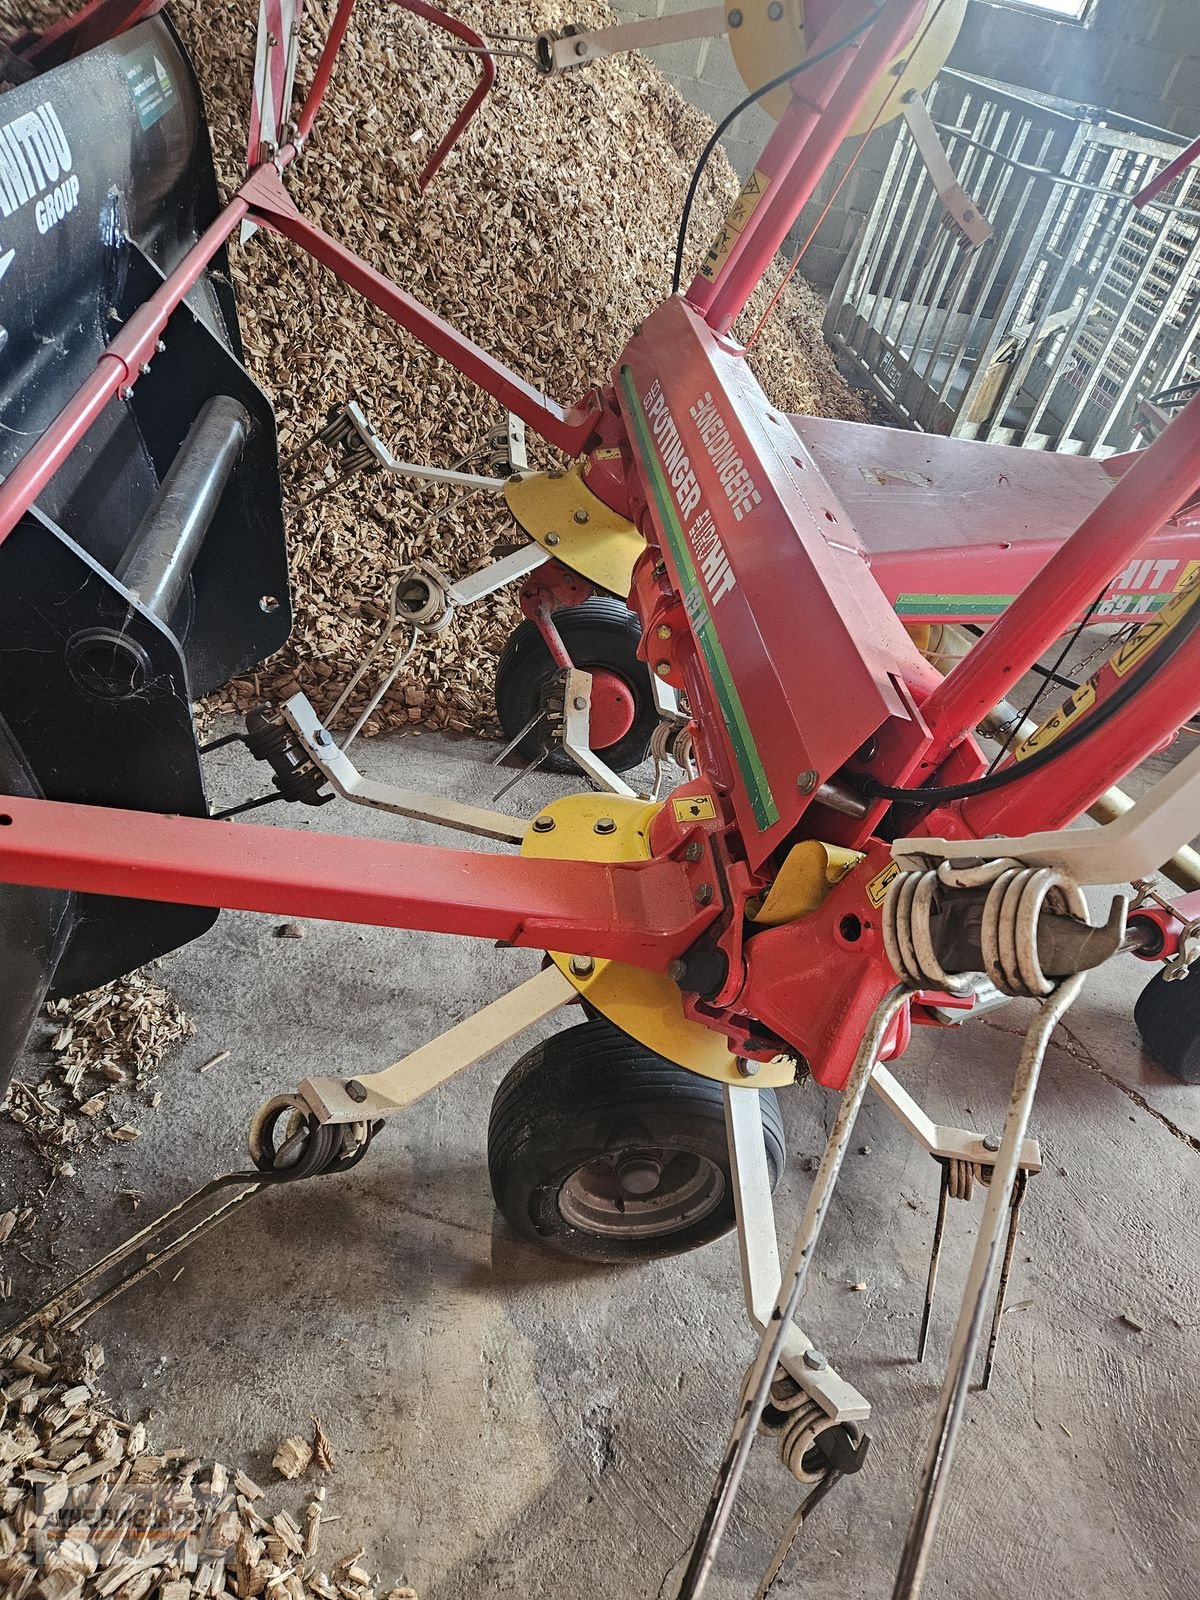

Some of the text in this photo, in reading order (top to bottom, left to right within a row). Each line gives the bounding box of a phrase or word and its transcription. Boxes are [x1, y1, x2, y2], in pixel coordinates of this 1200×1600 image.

[35, 174, 80, 235] GROUP
[693, 398, 755, 509] KNEIDINGER
[684, 586, 710, 634] 69 N
[1133, 596, 1155, 615] N
